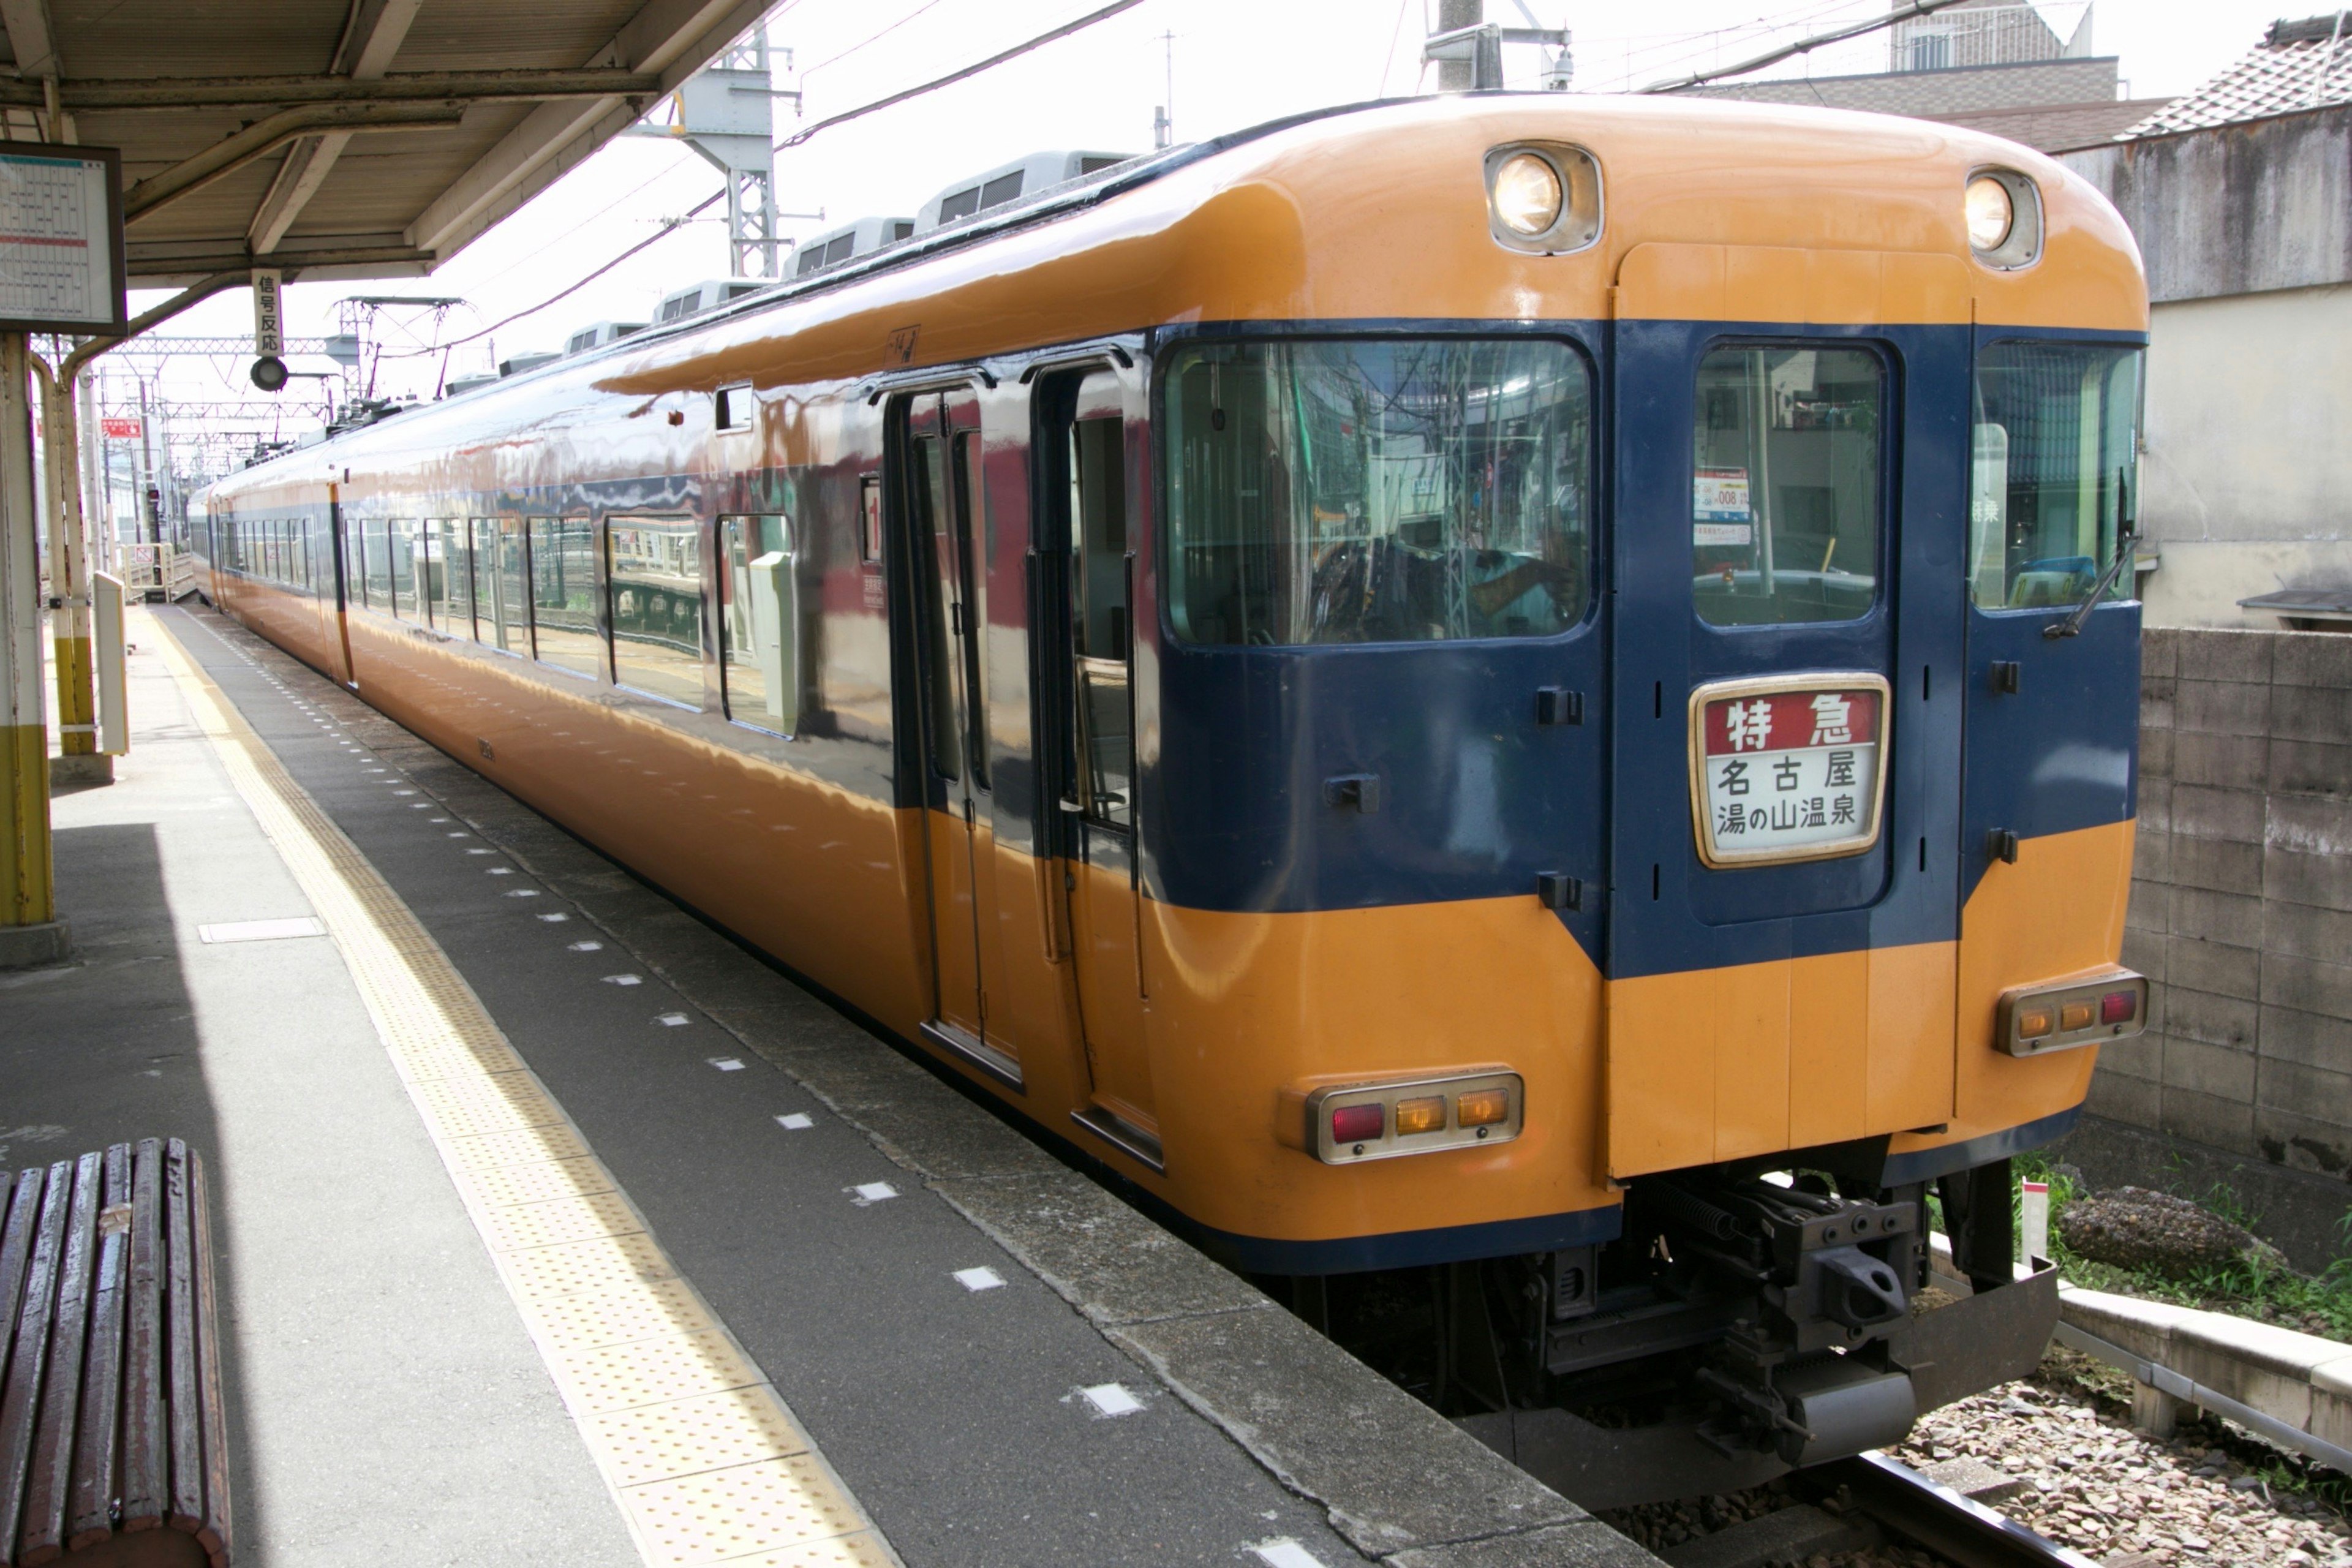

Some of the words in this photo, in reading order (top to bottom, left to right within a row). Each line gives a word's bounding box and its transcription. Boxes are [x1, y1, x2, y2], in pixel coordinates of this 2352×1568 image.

[258, 276, 277, 351] 信号反応
[1727, 694, 1852, 750] 特急
[1718, 752, 1855, 795] 名古屋
[1717, 794, 1856, 835] 湯の山温泉
